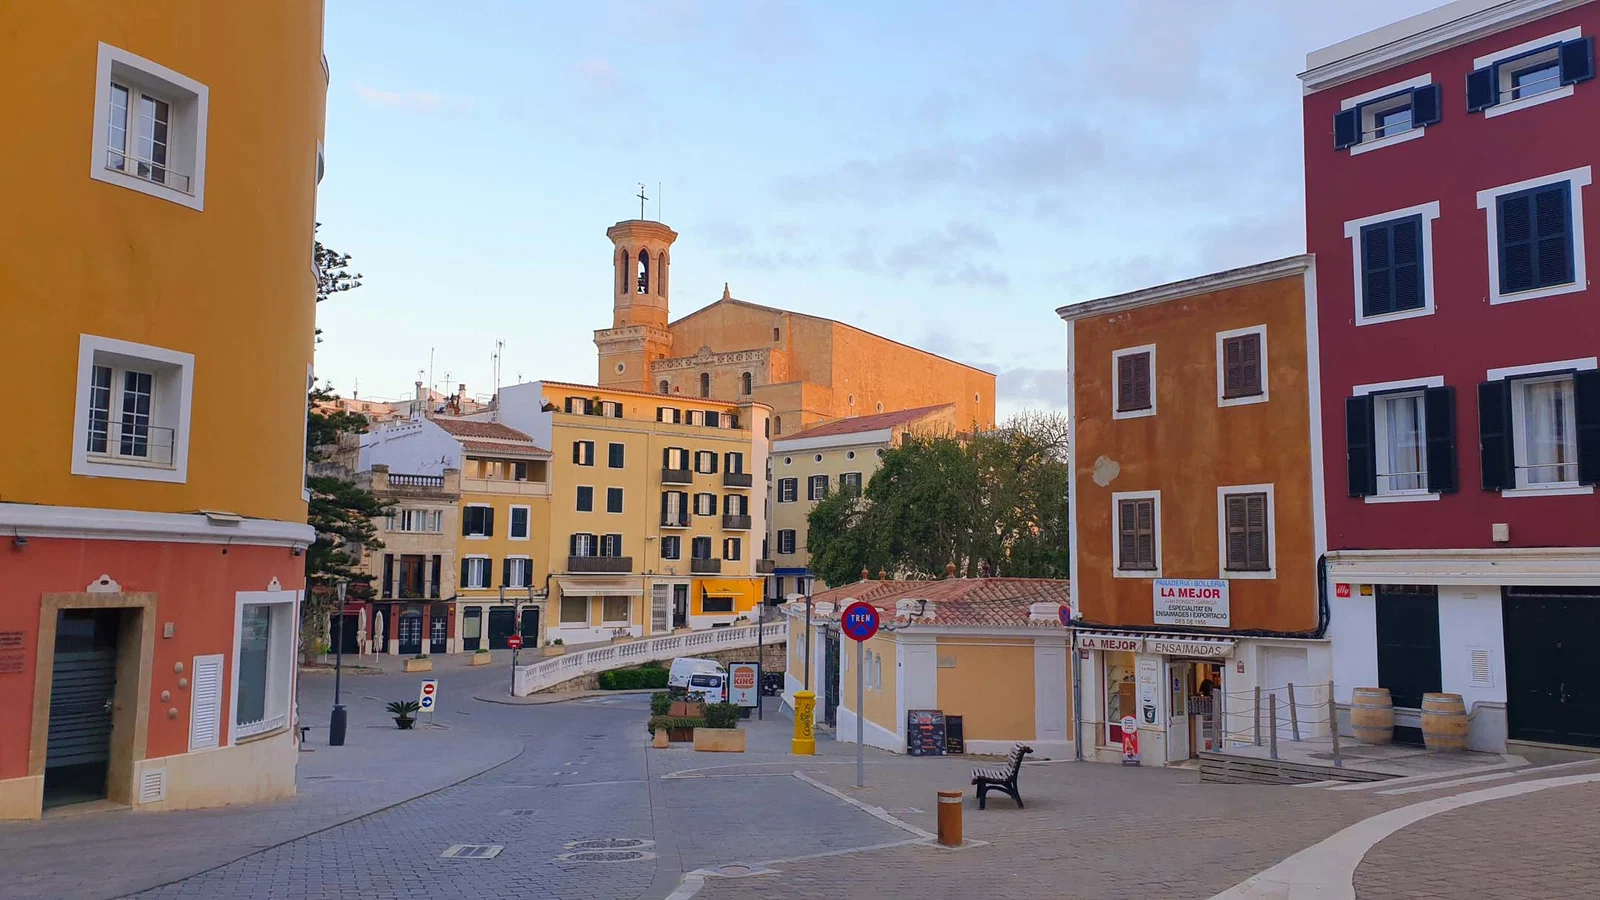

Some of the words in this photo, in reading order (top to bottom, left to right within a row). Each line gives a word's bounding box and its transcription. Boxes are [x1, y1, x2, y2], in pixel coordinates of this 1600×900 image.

[1161, 587, 1175, 597] LA
[1178, 588, 1220, 599] MEJOR
[1337, 585, 1349, 596] illy
[851, 614, 871, 622] TREN
[1082, 639, 1095, 648] LA
[1100, 639, 1137, 650] MEJOR
[1155, 642, 1222, 656] ENSAIMADAS
[733, 677, 754, 685] KING
